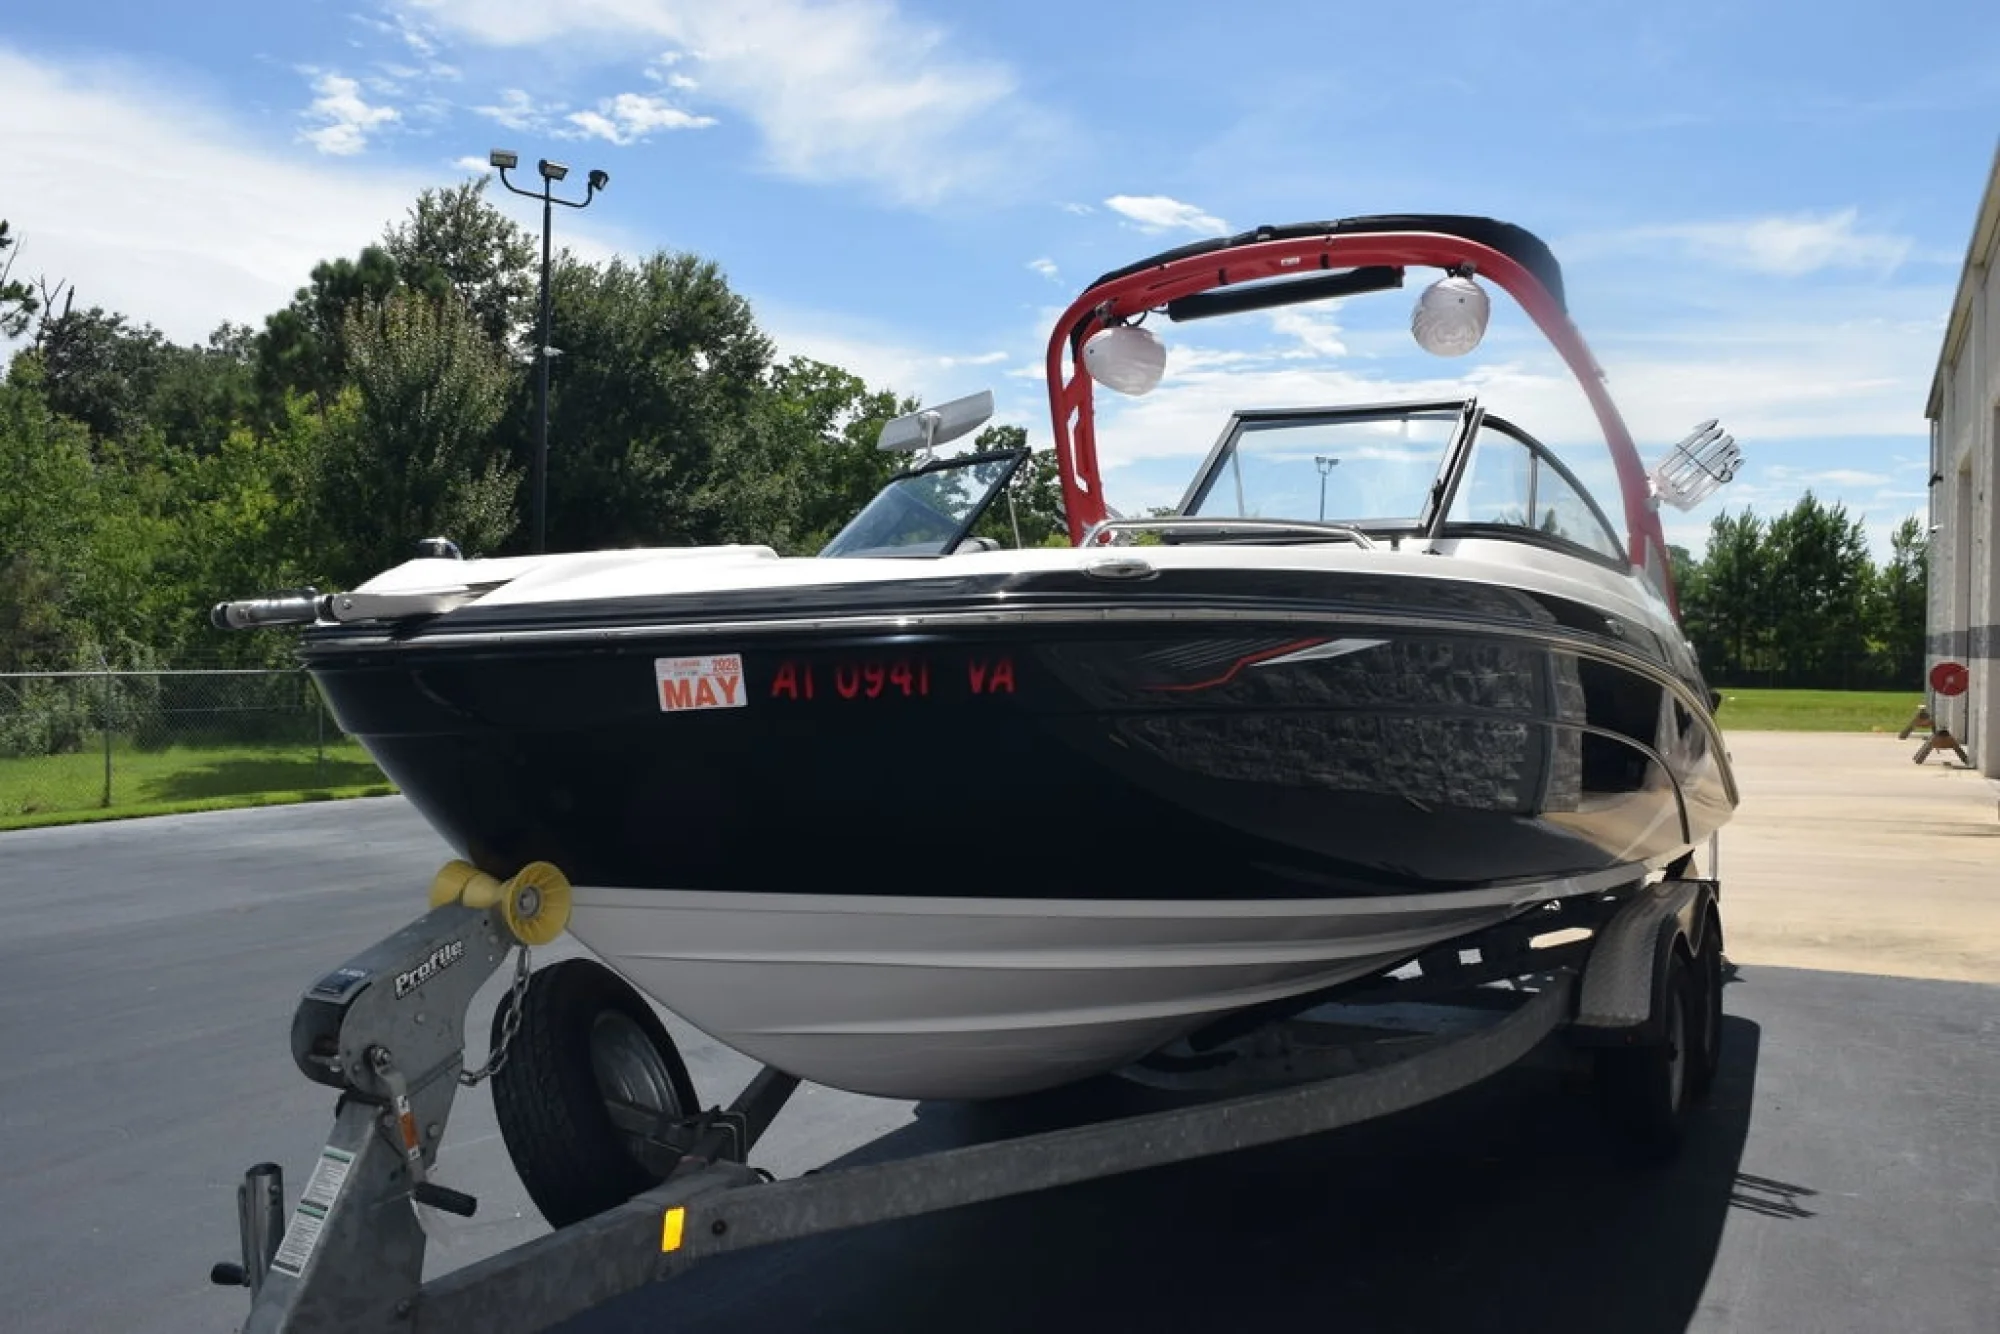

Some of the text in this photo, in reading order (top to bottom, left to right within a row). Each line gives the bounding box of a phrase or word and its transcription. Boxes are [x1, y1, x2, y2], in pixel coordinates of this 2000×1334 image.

[663, 675, 739, 709] MAY
[967, 656, 1016, 695] VA
[394, 940, 464, 1000] Profile
